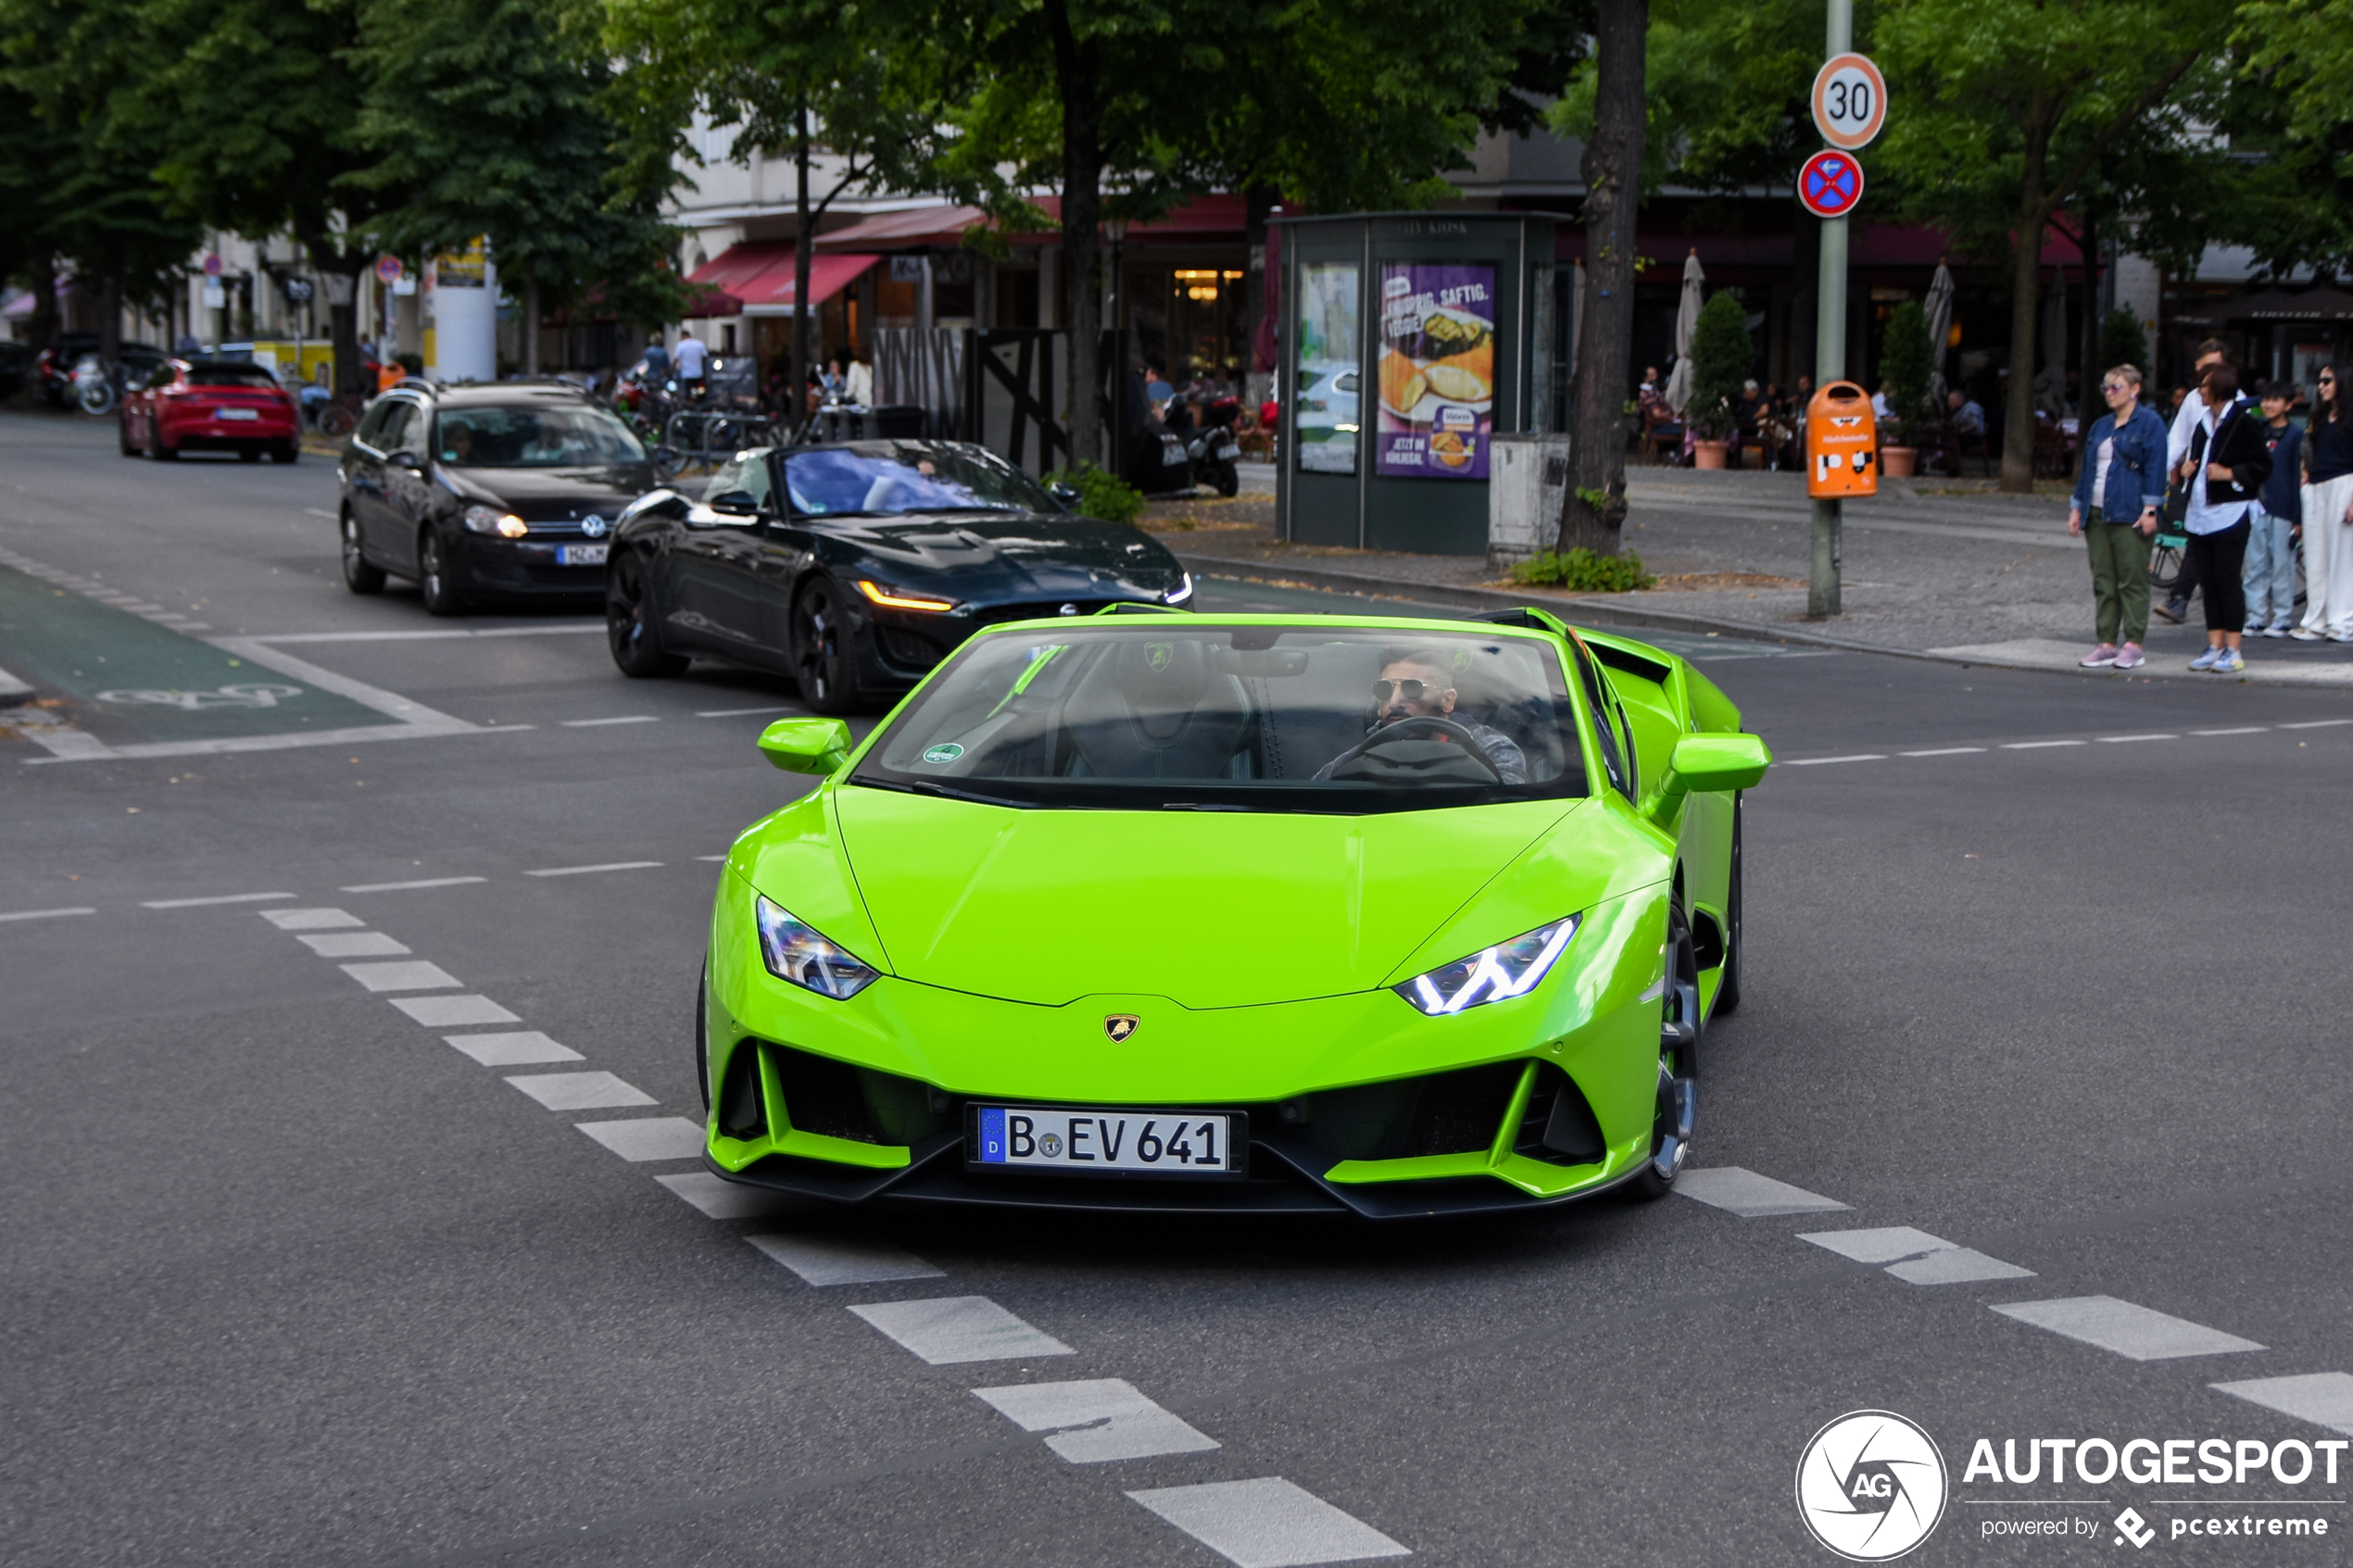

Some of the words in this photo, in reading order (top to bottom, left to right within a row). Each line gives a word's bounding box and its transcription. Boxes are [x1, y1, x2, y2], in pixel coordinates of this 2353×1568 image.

[1830, 81, 1869, 120] 30
[1441, 282, 1490, 307] SAFTIG.
[988, 1141, 999, 1154] D
[1009, 1115, 1036, 1158] B
[1068, 1118, 1126, 1161] EV
[1137, 1121, 1222, 1165] 641
